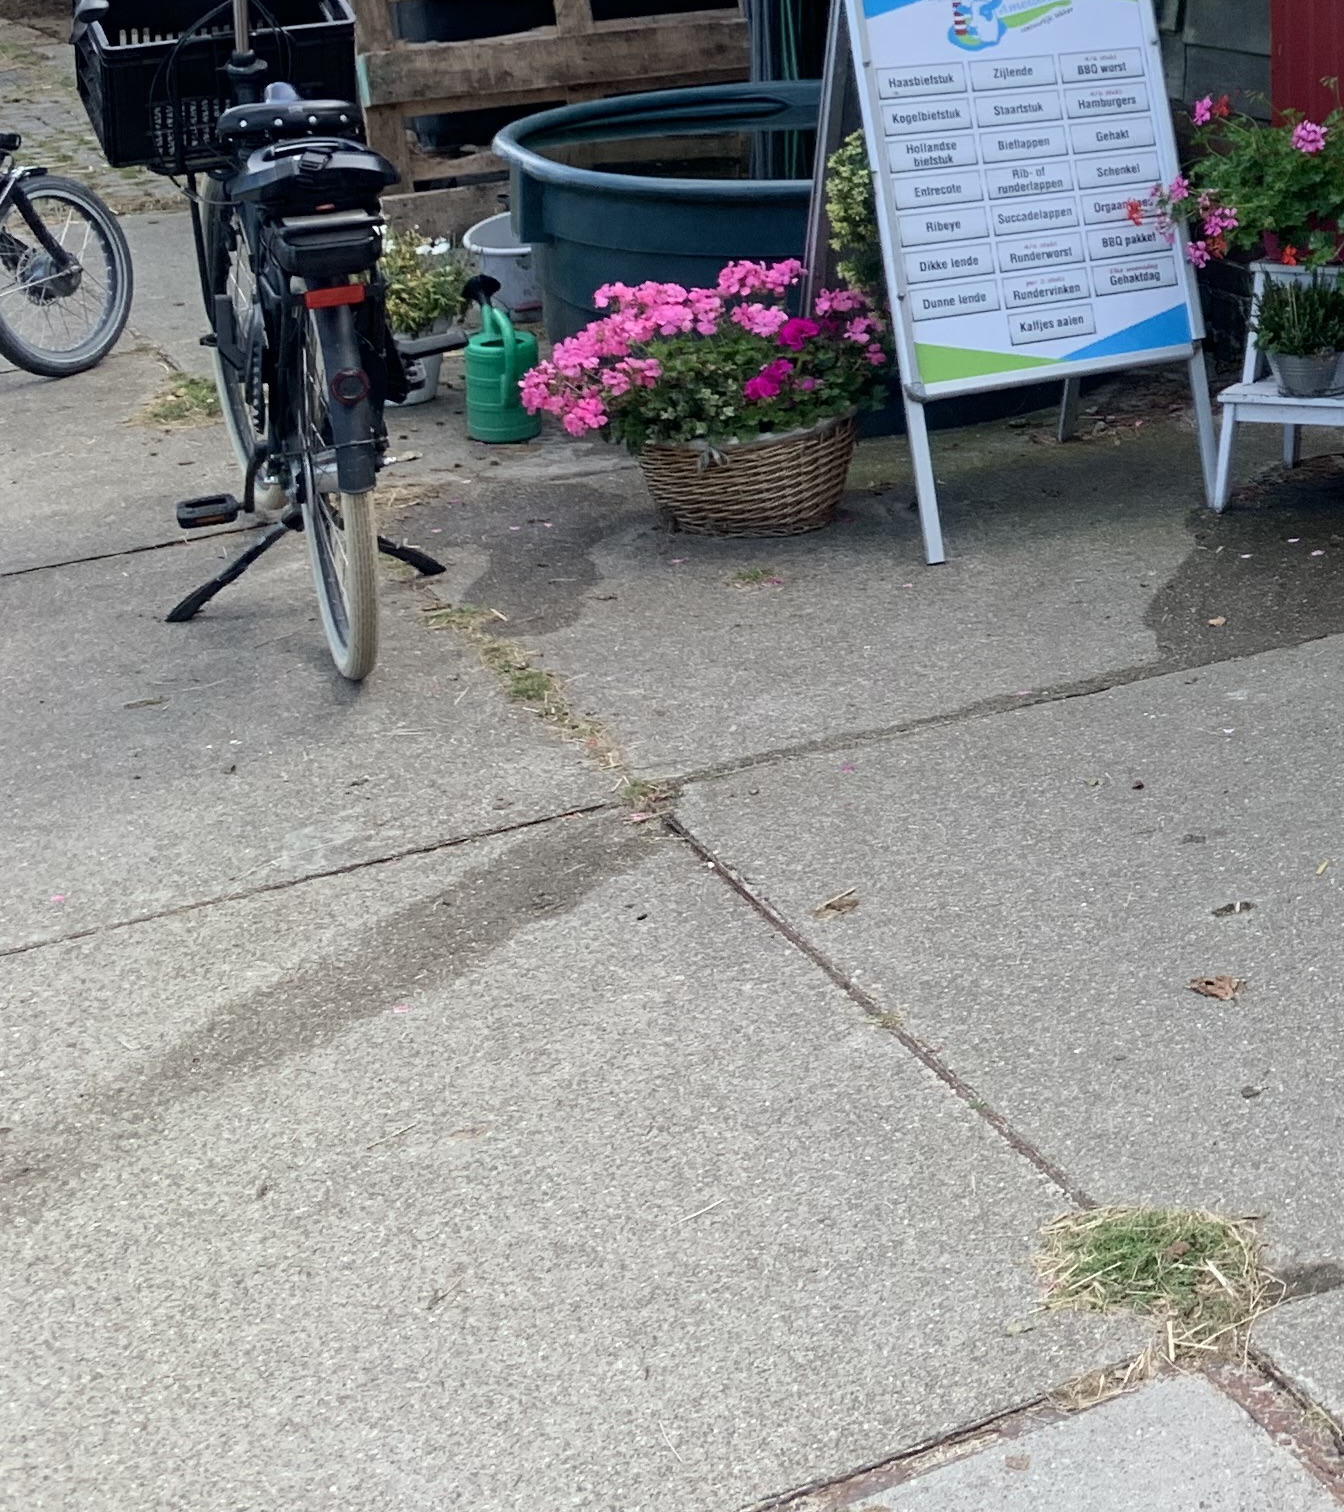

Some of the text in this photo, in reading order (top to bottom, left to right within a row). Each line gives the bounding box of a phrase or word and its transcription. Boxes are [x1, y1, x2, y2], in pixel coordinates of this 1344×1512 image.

[993, 66, 1033, 80] Zijlende
[1078, 64, 1098, 75] BBQ
[888, 73, 954, 88] Haasbiefstuk
[994, 102, 1044, 116] Staartstuk
[1078, 96, 1136, 109] Hamburgers
[892, 108, 961, 125] Kogelbiefstuk
[1096, 130, 1130, 142] Gehakt
[906, 141, 957, 154] Hollandse
[998, 137, 1050, 151] Bieflappen
[914, 154, 954, 167] biefstuk
[1012, 166, 1045, 179] Rib- of
[1097, 163, 1140, 178] Schenkel
[914, 184, 962, 197] Entrecote
[998, 179, 1063, 194] runderlappen
[998, 208, 1072, 224] Succadelappen
[926, 220, 961, 233] Ribeye
[1102, 232, 1156, 248] BBQ pakket
[1010, 247, 1072, 264] Runderworst
[920, 256, 979, 272] Dikke lende
[1110, 270, 1161, 286] Gehaktdag
[1013, 284, 1081, 301] Rundervinken
[922, 292, 986, 310] Dunne lende
[1020, 314, 1084, 333] Kalfjes aaien
